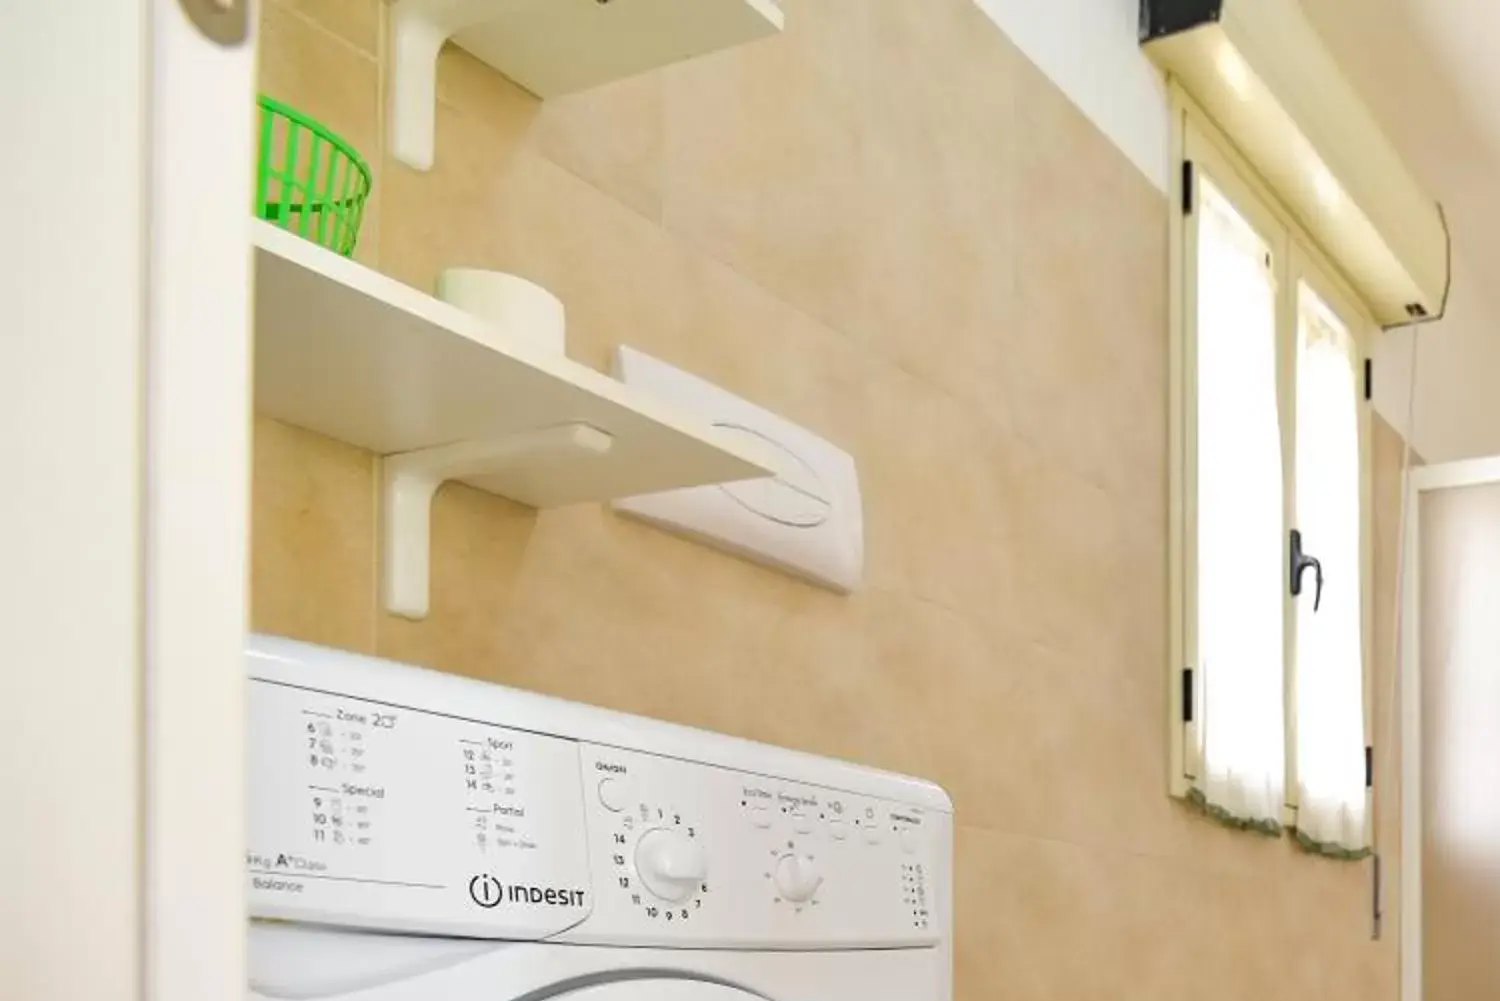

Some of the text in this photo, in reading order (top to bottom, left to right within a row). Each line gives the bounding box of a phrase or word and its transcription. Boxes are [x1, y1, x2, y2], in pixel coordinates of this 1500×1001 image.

[313, 812, 327, 825] 10
[314, 829, 326, 842] 11
[252, 876, 305, 894] Balance
